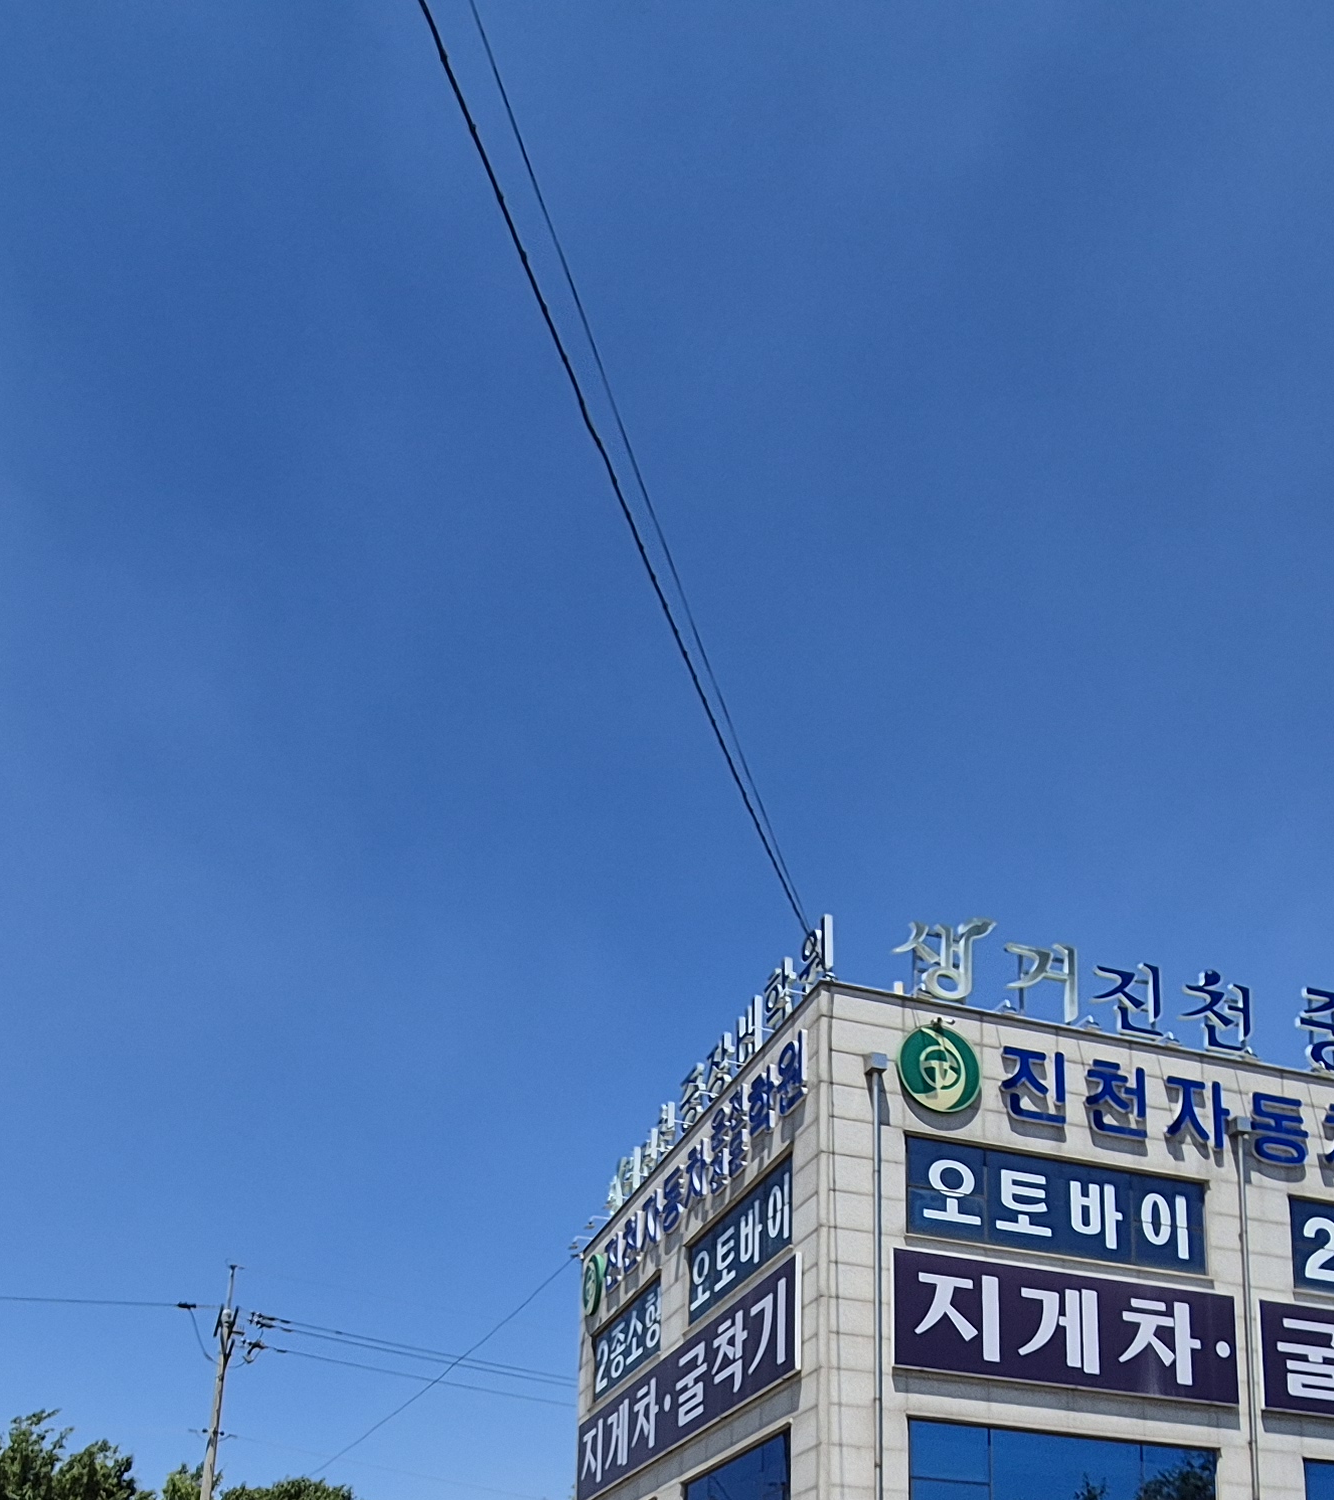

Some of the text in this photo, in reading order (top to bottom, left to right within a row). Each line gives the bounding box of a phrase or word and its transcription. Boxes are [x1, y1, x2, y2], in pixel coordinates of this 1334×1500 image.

[892, 917, 1255, 1052] 생거진천
[689, 1171, 790, 1312] 오토바이
[923, 1158, 1190, 1260] 오토바이
[594, 1288, 662, 1394] 2종소형
